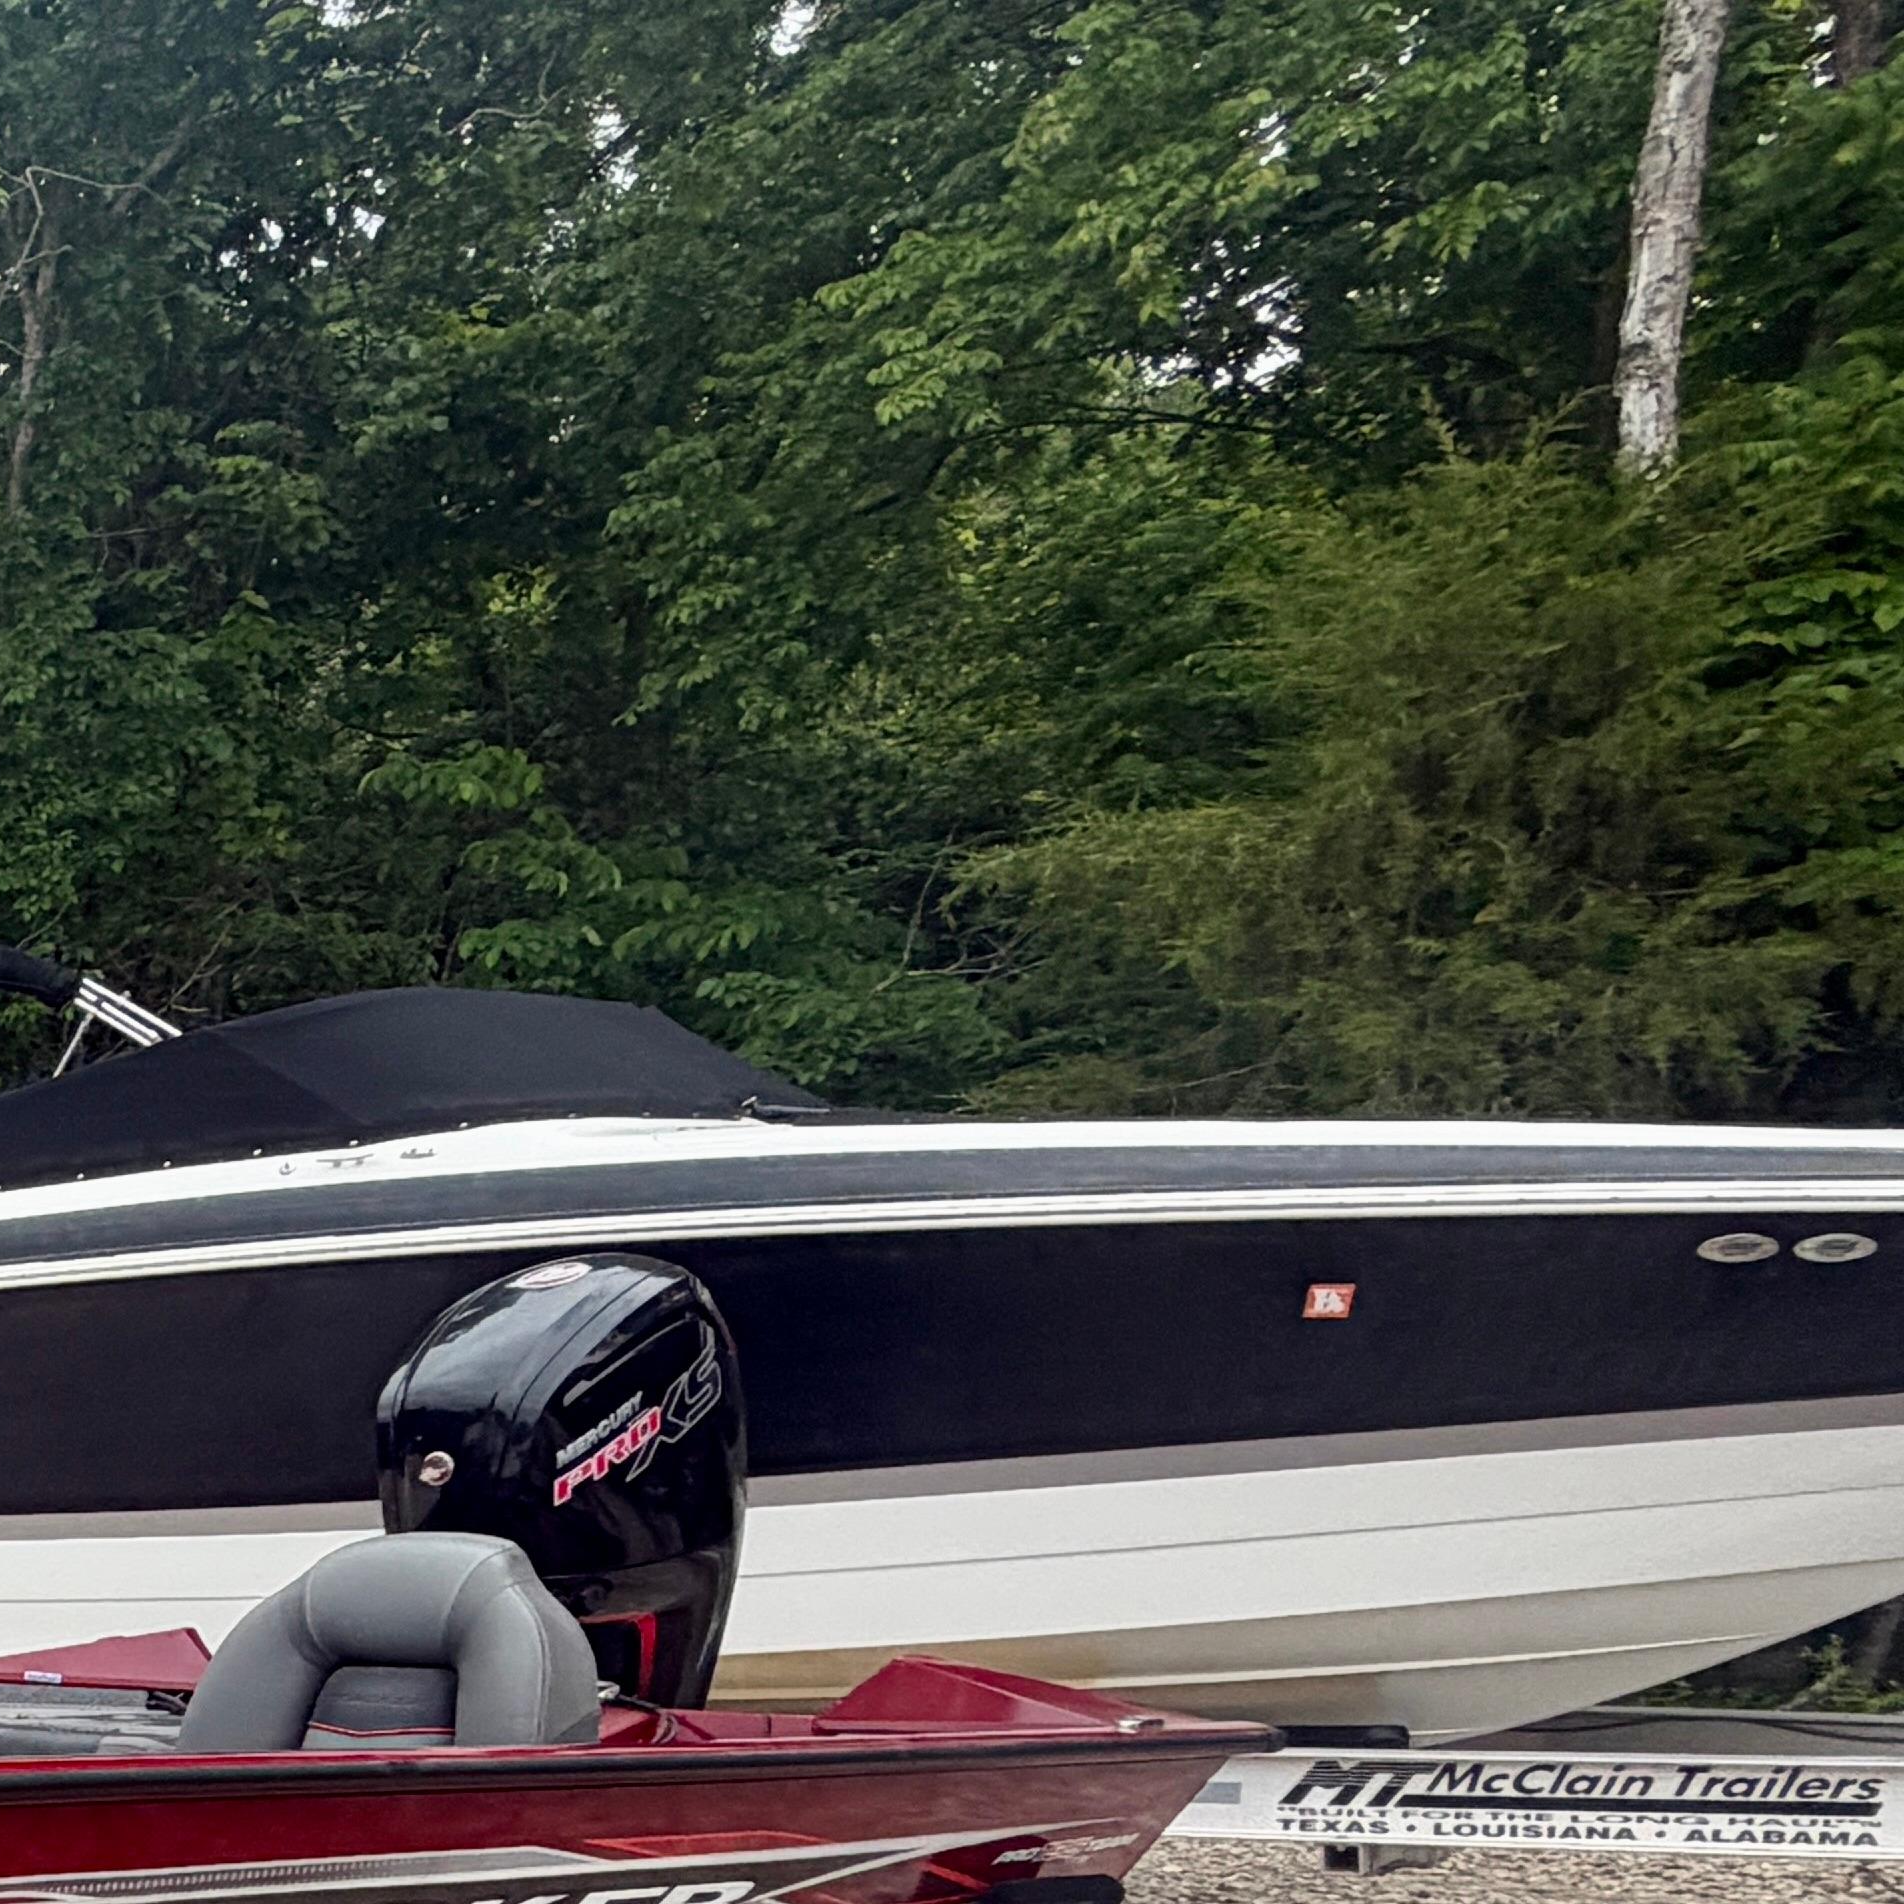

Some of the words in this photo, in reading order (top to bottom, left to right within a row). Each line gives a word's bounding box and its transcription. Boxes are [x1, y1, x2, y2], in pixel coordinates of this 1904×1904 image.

[556, 1390, 643, 1469] MERCURY
[1426, 1762, 1655, 1797] McClain
[1674, 1764, 1887, 1800] Trailers
[1277, 1818, 1390, 1834] TEXAS
[1432, 1822, 1637, 1840] LOUISIANA
[1683, 1828, 1880, 1847] ALABAMA
[1402, 1809, 1473, 1820] FOR
[1485, 1811, 1553, 1822] THE
[1570, 1813, 1710, 1825] LONG
